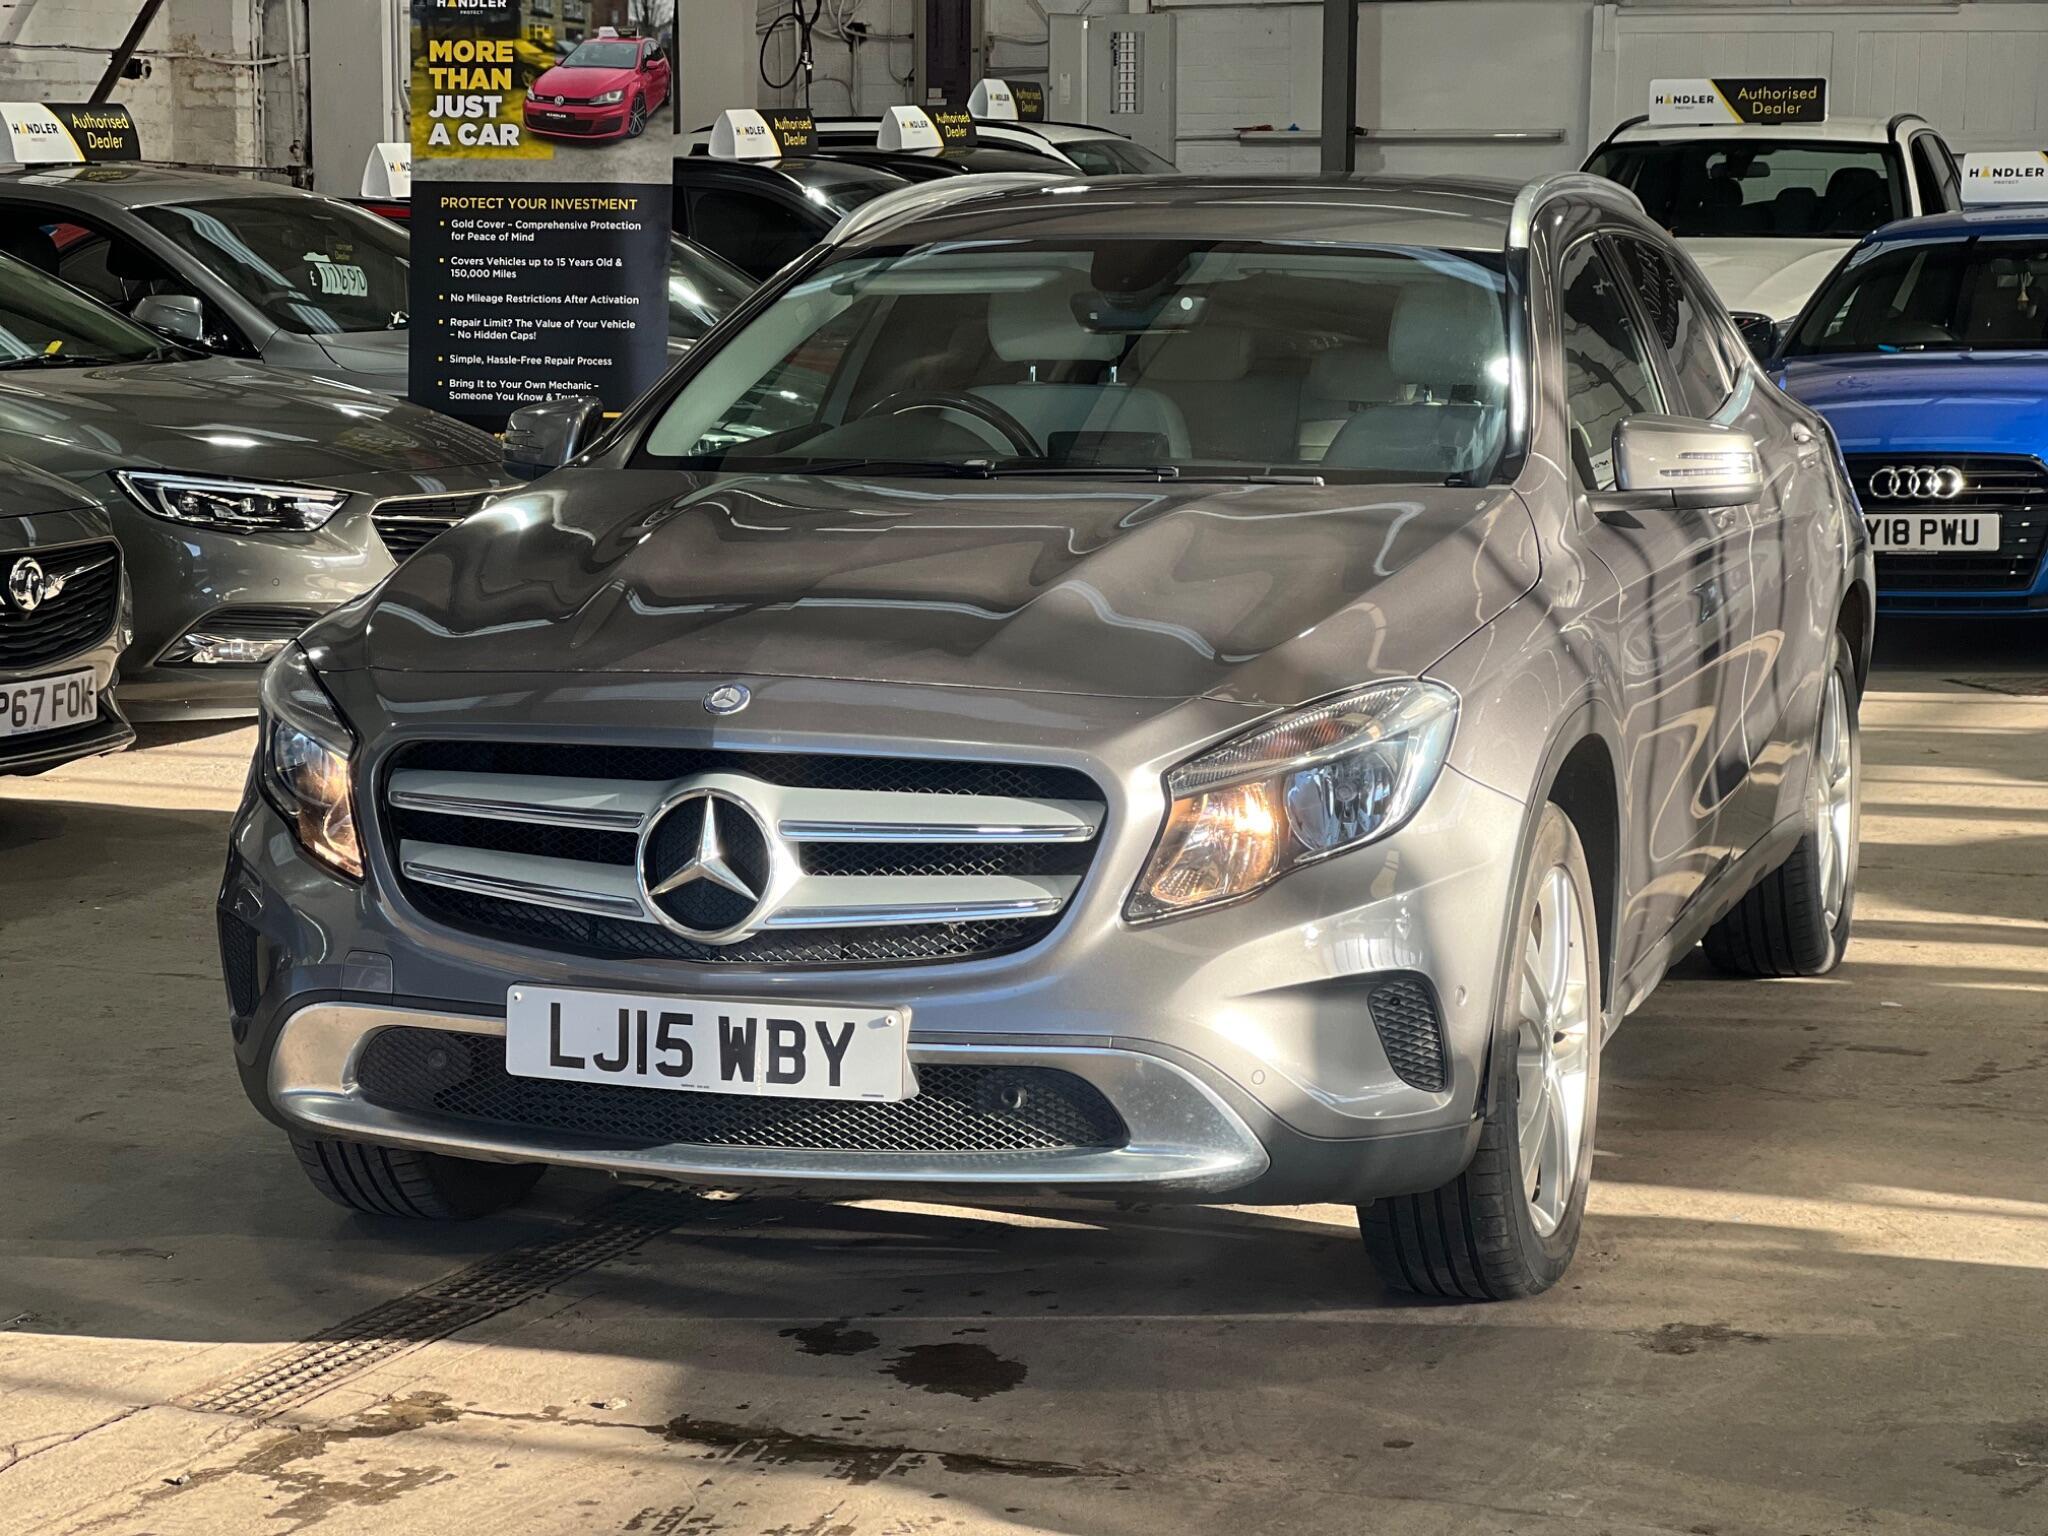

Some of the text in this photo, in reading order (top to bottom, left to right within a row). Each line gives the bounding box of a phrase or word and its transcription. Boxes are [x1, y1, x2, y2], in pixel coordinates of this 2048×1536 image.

[437, 0, 506, 8] HANDLER
[429, 40, 513, 63] MORE
[429, 67, 512, 90] THAN
[1655, 94, 1714, 104] HANDLER
[1738, 85, 1817, 100] Authorised
[429, 95, 502, 119] JUST
[1752, 101, 1801, 115] Dealer
[71, 112, 129, 129] Authorised
[774, 117, 812, 131] Authorised
[935, 110, 970, 125] Authorised
[12, 123, 59, 135] HANDLER
[428, 123, 520, 146] A CAR
[736, 125, 766, 136] HANDLER
[945, 124, 967, 139] Dealer
[87, 131, 123, 149] Dealer
[784, 131, 808, 147] Dealer
[1969, 167, 2045, 178] HANDLER
[441, 197, 638, 210] PROTECT YOUR INVESTMENT
[451, 219, 474, 229] Gold
[476, 220, 505, 229] Cover
[515, 220, 588, 232] Comprehensive
[590, 220, 641, 231] Protection
[451, 232, 535, 242] for Peace of Mind
[450, 256, 623, 269] Covers Vehicles up to 15 Years Old &
[451, 269, 517, 280] 150,000 Miles
[450, 293, 639, 305] No Mileage Restrictions After Activation
[450, 318, 636, 329] Repair Limit? The Value of Your Vehicle
[457, 331, 471, 340] No
[473, 331, 508, 340] Hidden
[510, 331, 537, 342] Caps!
[449, 354, 613, 367] Simple, Hassle-Free Repair Process
[449, 379, 475, 390] Bring
[477, 380, 484, 389] It
[486, 380, 497, 389] to
[499, 380, 522, 389] Your
[524, 380, 546, 390] Own
[548, 381, 592, 390] Mechanic
[449, 391, 493, 400] Someone
[496, 392, 514, 401] You
[517, 392, 543, 401] Know
[546, 392, 553, 401] &
[1866, 519, 1979, 545] Y18 PWU
[51, 676, 94, 721] FOK
[550, 1002, 855, 1087] LJ15 WBY
